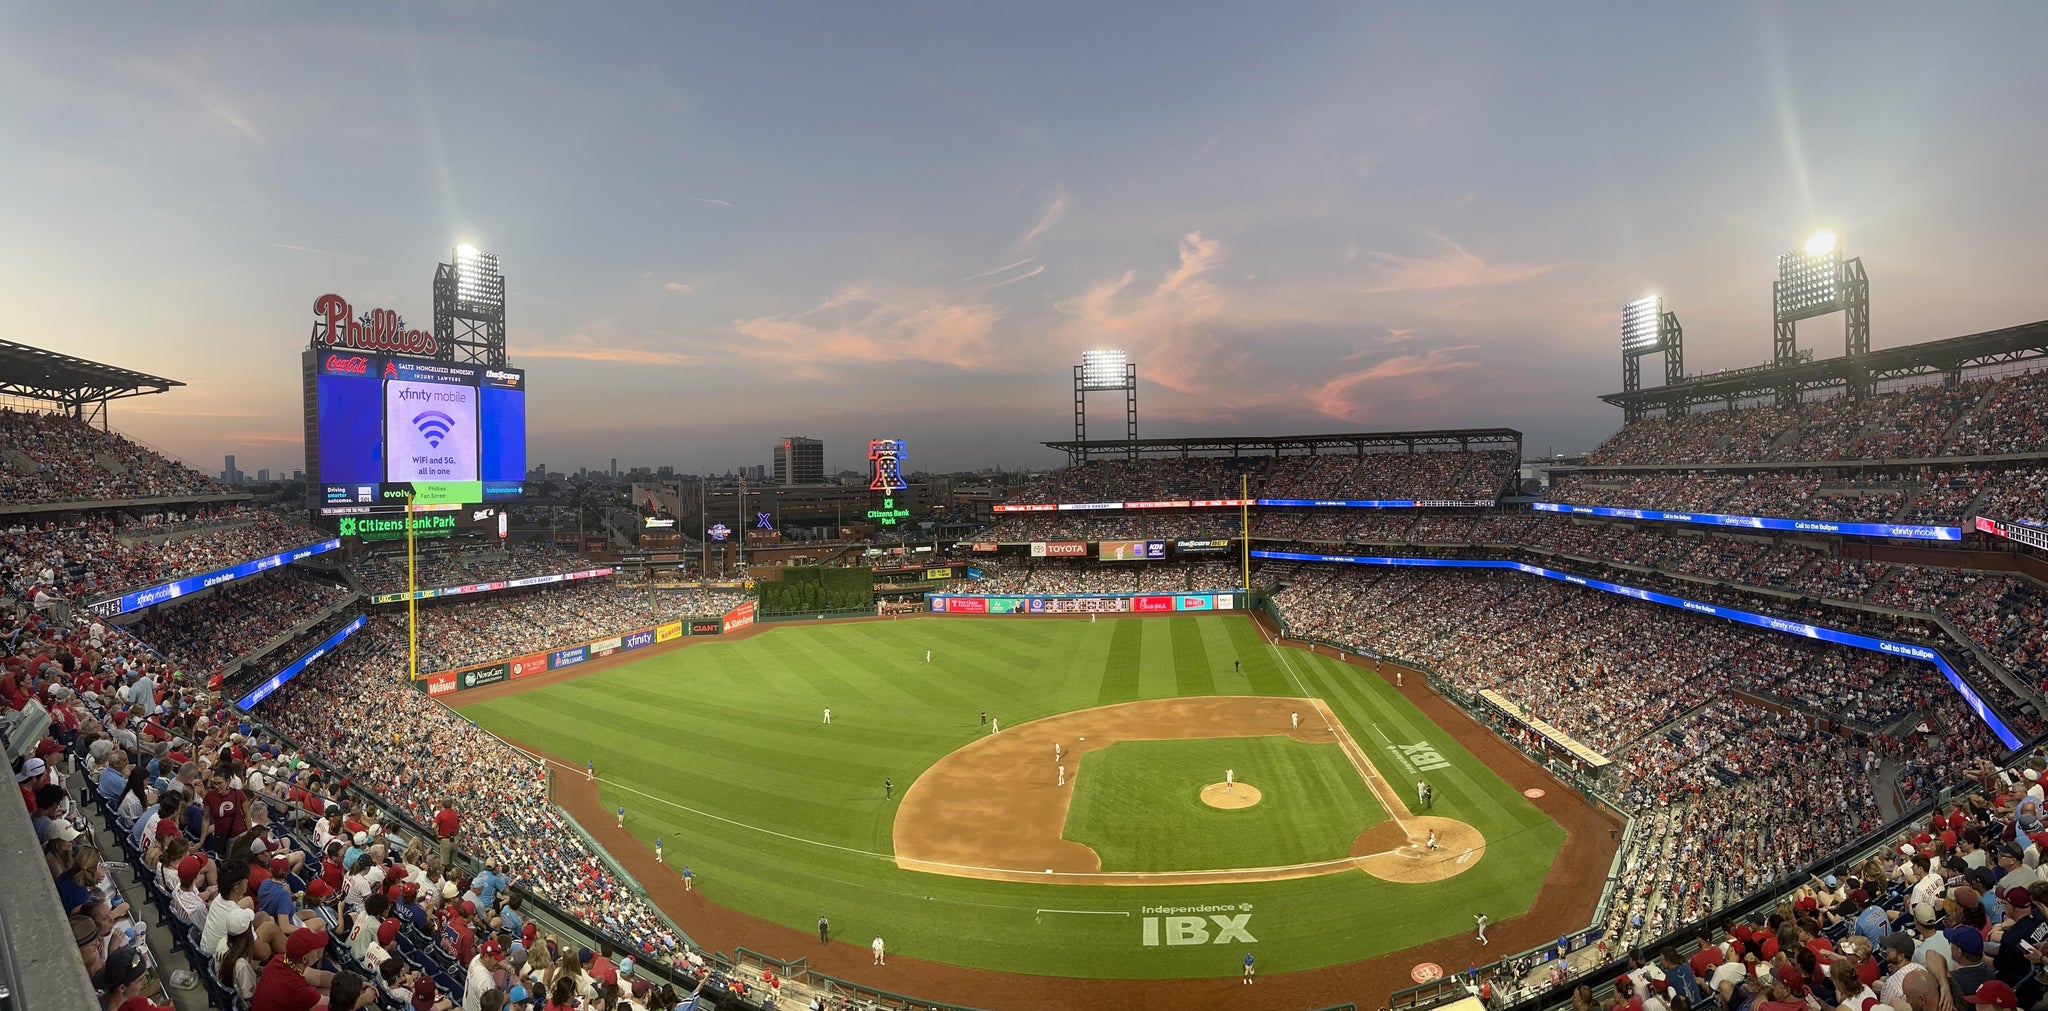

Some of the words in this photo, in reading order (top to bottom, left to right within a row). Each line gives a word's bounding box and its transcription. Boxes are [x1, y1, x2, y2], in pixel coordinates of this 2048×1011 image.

[314, 293, 438, 356] Phillies
[326, 354, 369, 374] Coca-Cola
[398, 363, 414, 371] SALTZ
[450, 368, 475, 376] BENDESKY
[485, 370, 520, 380] theScore
[398, 387, 432, 402] xfinity
[433, 390, 467, 403] mobile
[412, 456, 428, 464] WiFi
[429, 456, 443, 464] and
[444, 456, 456, 465] 5G,
[418, 467, 428, 475] all
[429, 467, 436, 475] in
[867, 510, 893, 518] Citizens
[893, 509, 910, 517] Bank
[358, 519, 403, 532] Citizens
[433, 514, 455, 527] Park
[1820, 524, 1839, 532] Bullpen
[1891, 526, 1913, 537] xfinity
[1048, 545, 1083, 553] TOYOTA
[137, 593, 154, 605] xfinity
[1770, 620, 1788, 631] xfinity
[627, 633, 652, 648] xfinity
[562, 649, 583, 658] SHERWIN
[1880, 642, 1892, 651] Call
[1900, 645, 1911, 655] the
[562, 656, 584, 665] WILLIAMS
[476, 668, 503, 680] NovaCare
[429, 681, 456, 694] Wawa
[1398, 740, 1451, 772] IBX
[219, 800, 234, 818] P
[1141, 904, 1235, 915] Independence
[350, 926, 360, 941] 3
[1142, 914, 1259, 946] IBX
[1879, 920, 1888, 936] 7
